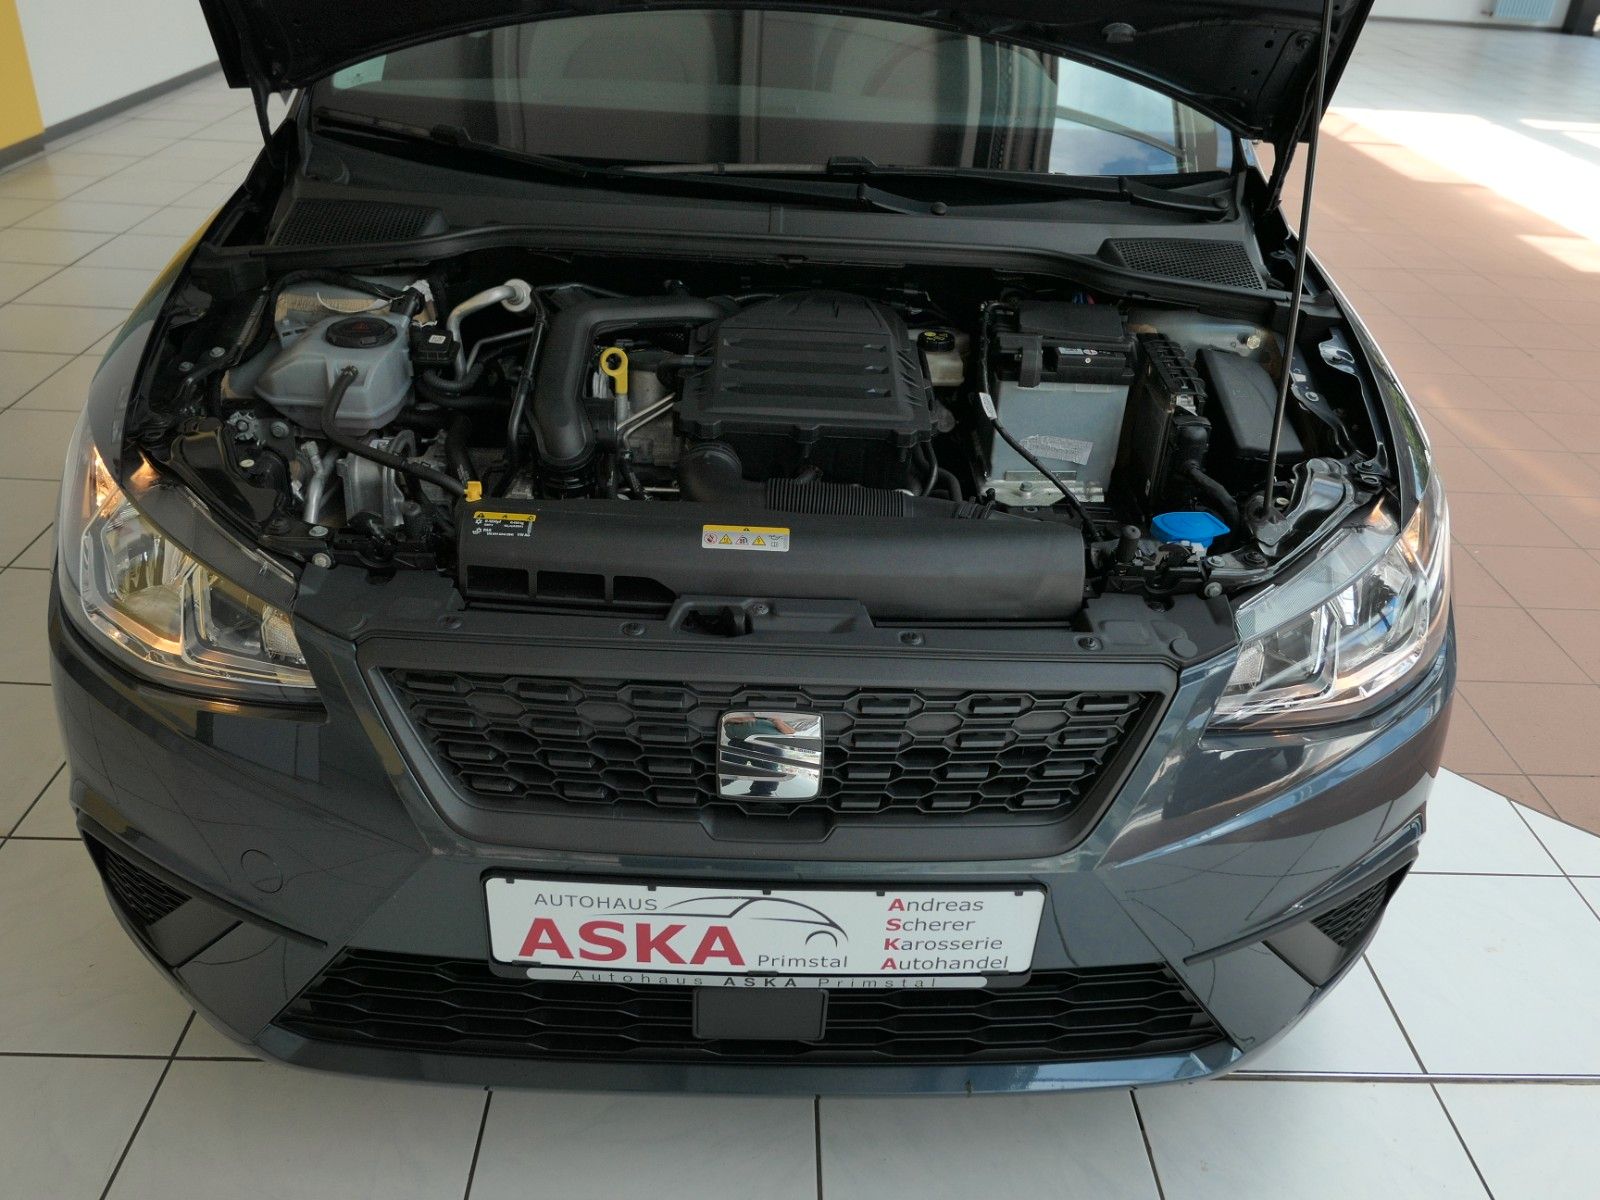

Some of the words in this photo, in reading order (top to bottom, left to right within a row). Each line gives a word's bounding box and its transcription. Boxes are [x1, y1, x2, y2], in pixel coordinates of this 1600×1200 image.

[534, 892, 658, 911] AUTOHAUS
[888, 898, 984, 912] Andreas
[885, 917, 976, 932] Scherer
[518, 917, 746, 967] ASKA
[883, 936, 1003, 951] Karosserie
[758, 954, 848, 969] Primstal
[880, 956, 1009, 971] Autohandel
[571, 970, 703, 985] Autohaus
[723, 977, 798, 988] ASKA
[818, 977, 936, 988] Primstal
